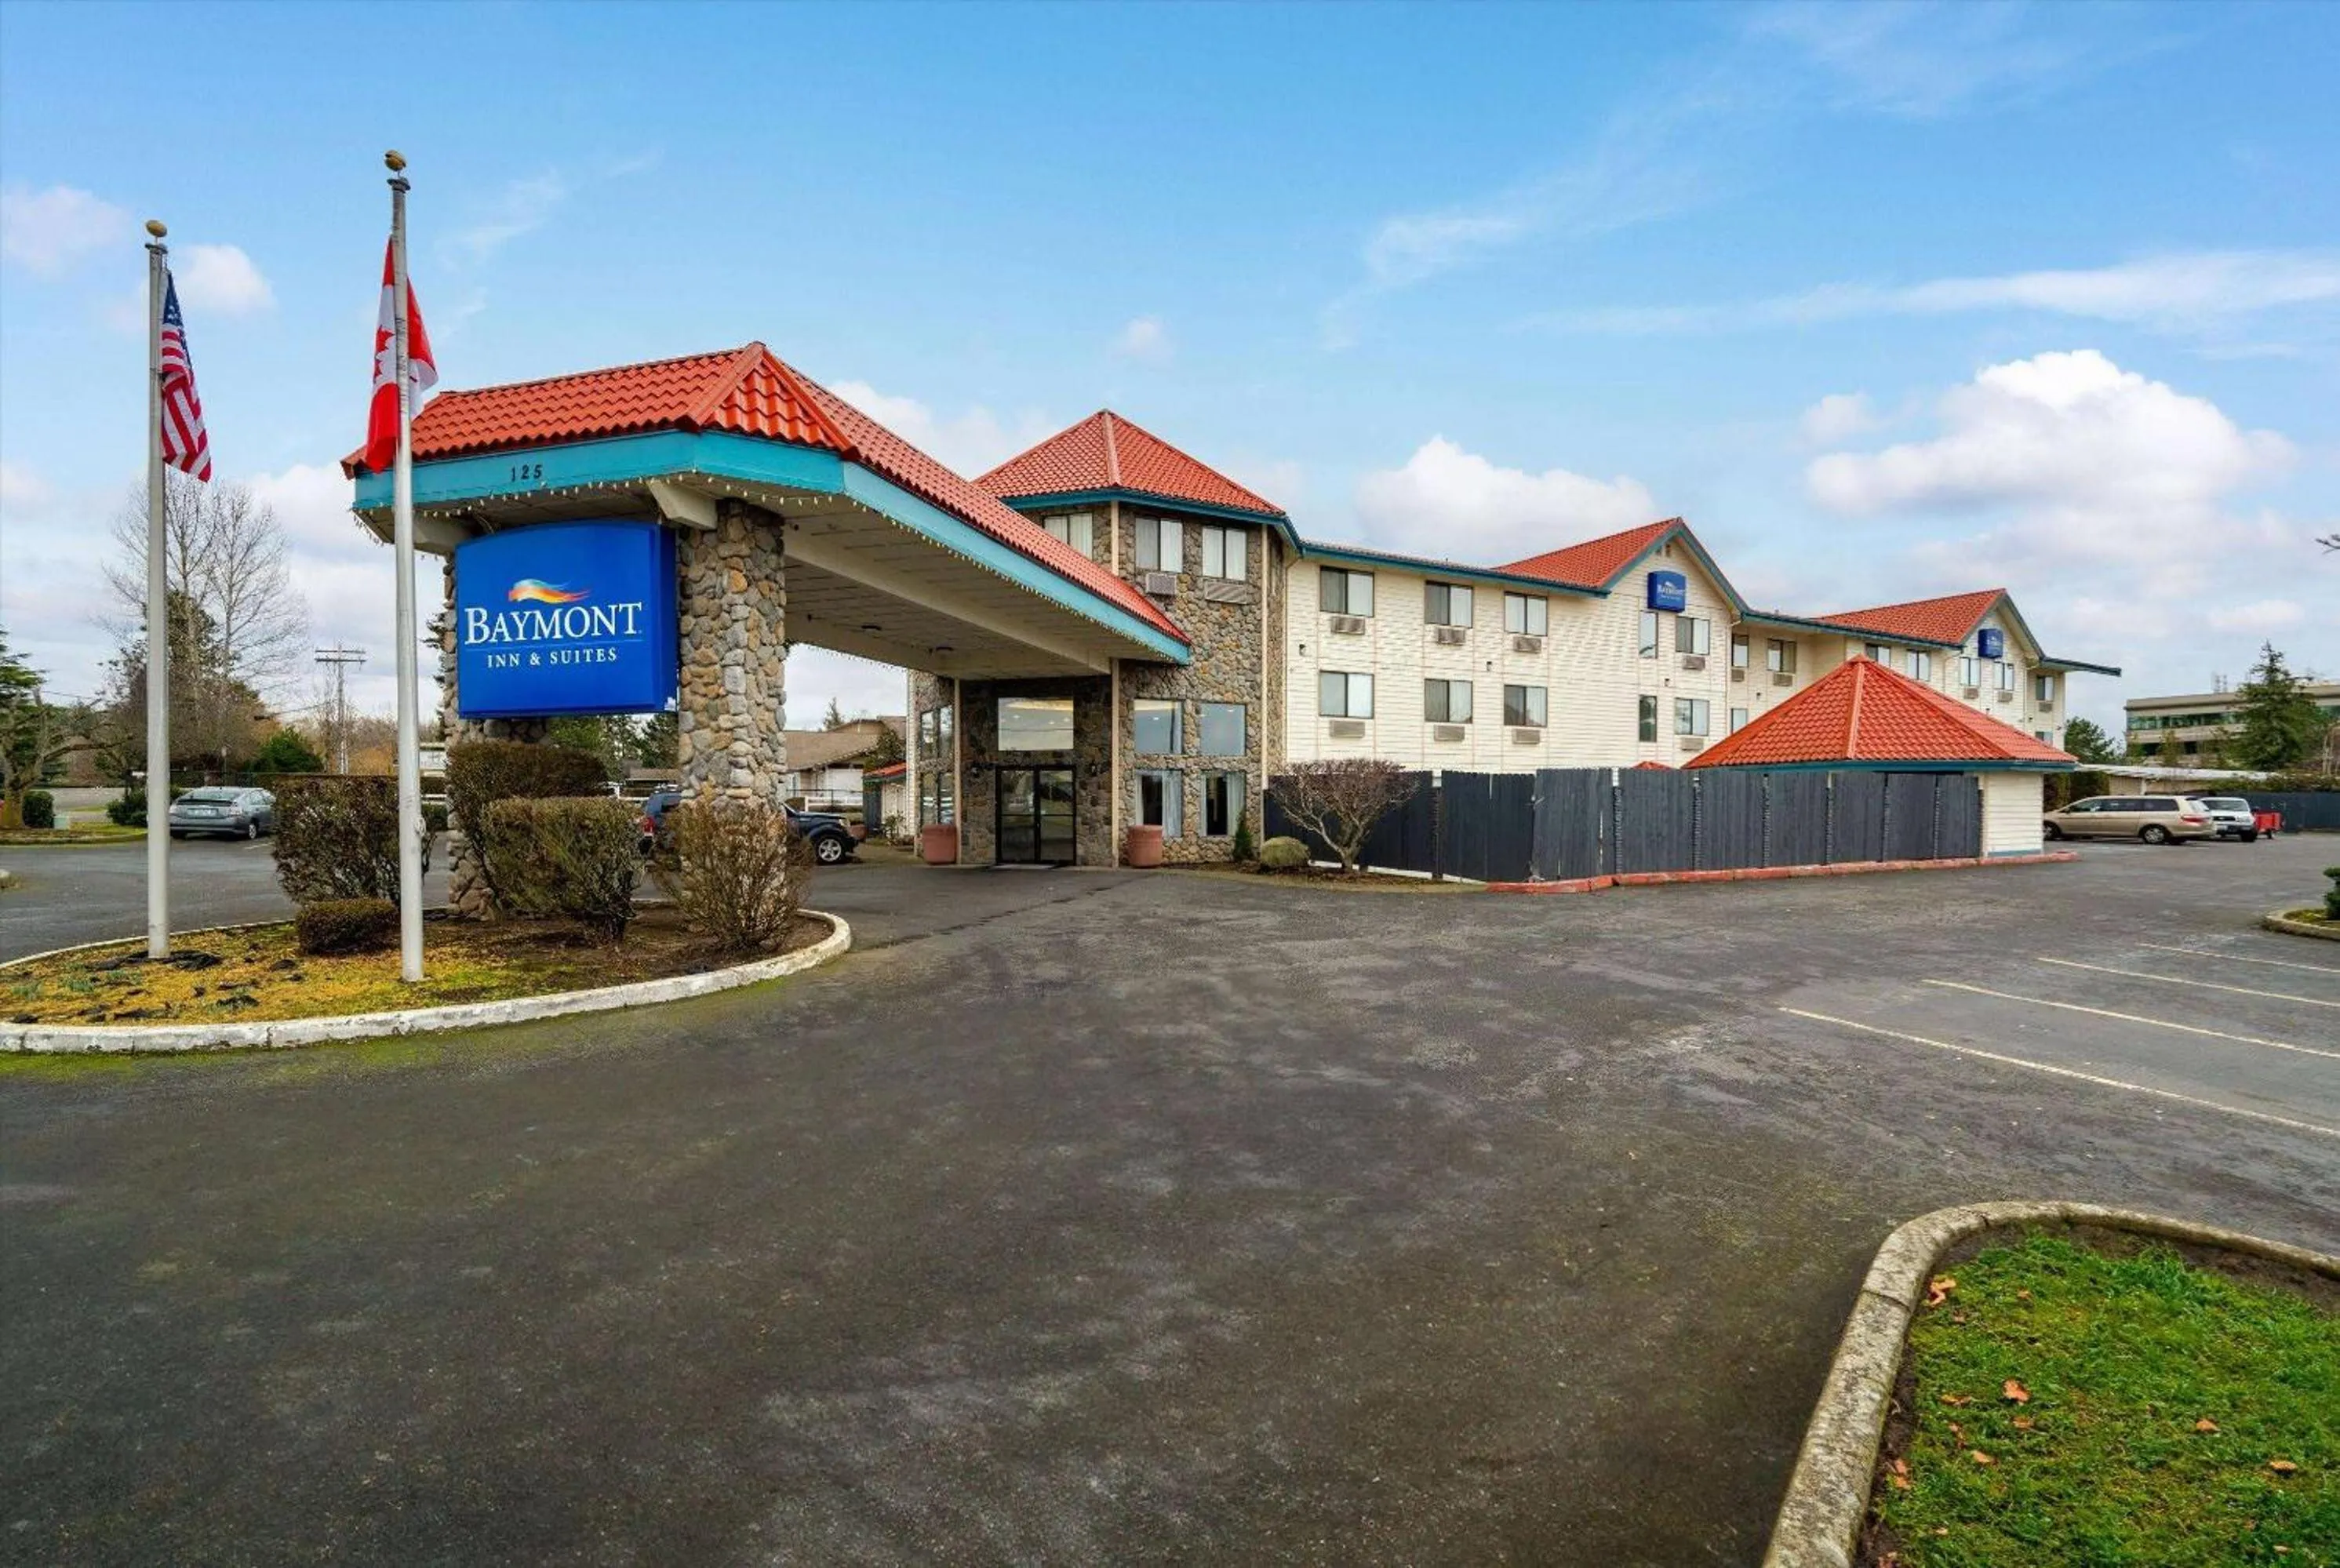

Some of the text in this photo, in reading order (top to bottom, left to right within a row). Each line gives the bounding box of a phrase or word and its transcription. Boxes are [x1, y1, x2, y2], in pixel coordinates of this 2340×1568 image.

[511, 464, 542, 482] 125
[464, 602, 642, 645] BAYMONT
[487, 647, 617, 668] INN & SUITES
